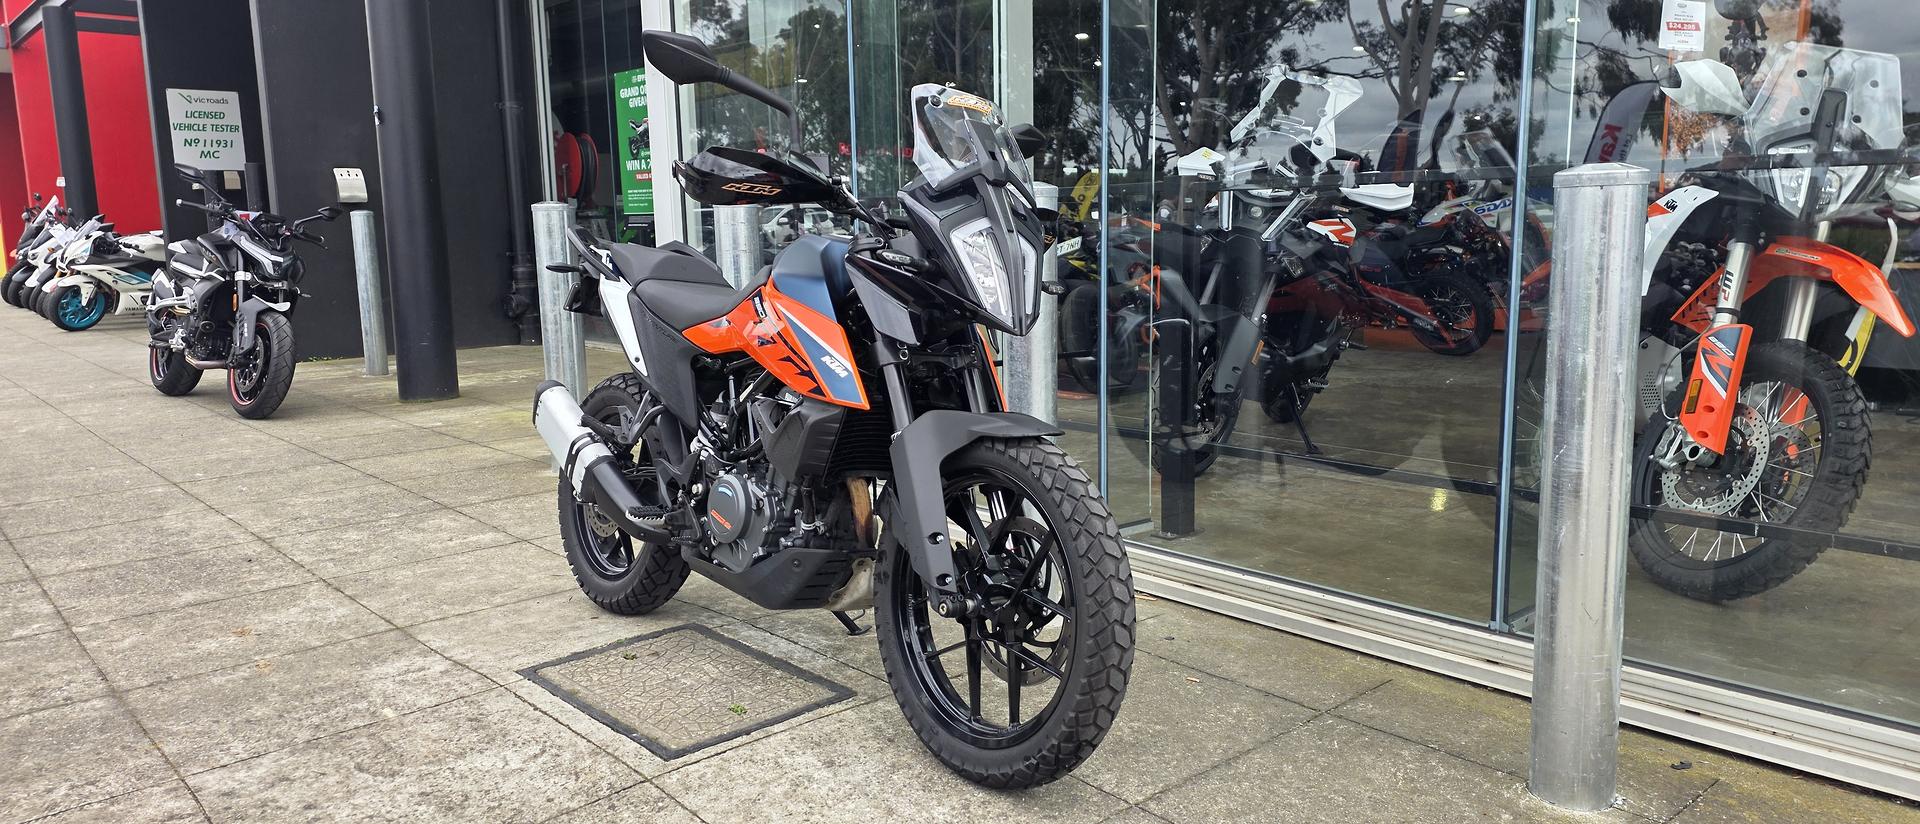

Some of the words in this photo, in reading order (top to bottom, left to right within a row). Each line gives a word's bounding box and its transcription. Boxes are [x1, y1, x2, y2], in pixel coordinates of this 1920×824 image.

[619, 86, 639, 98] GRAND
[185, 110, 225, 120] LICENSED
[172, 122, 207, 132] VEHICLE
[210, 123, 240, 133] TESTER
[203, 139, 234, 149] 11931
[199, 150, 220, 159] MC
[625, 159, 640, 171] WIN
[1663, 198, 1679, 213] KTM
[820, 355, 849, 378] KTM
